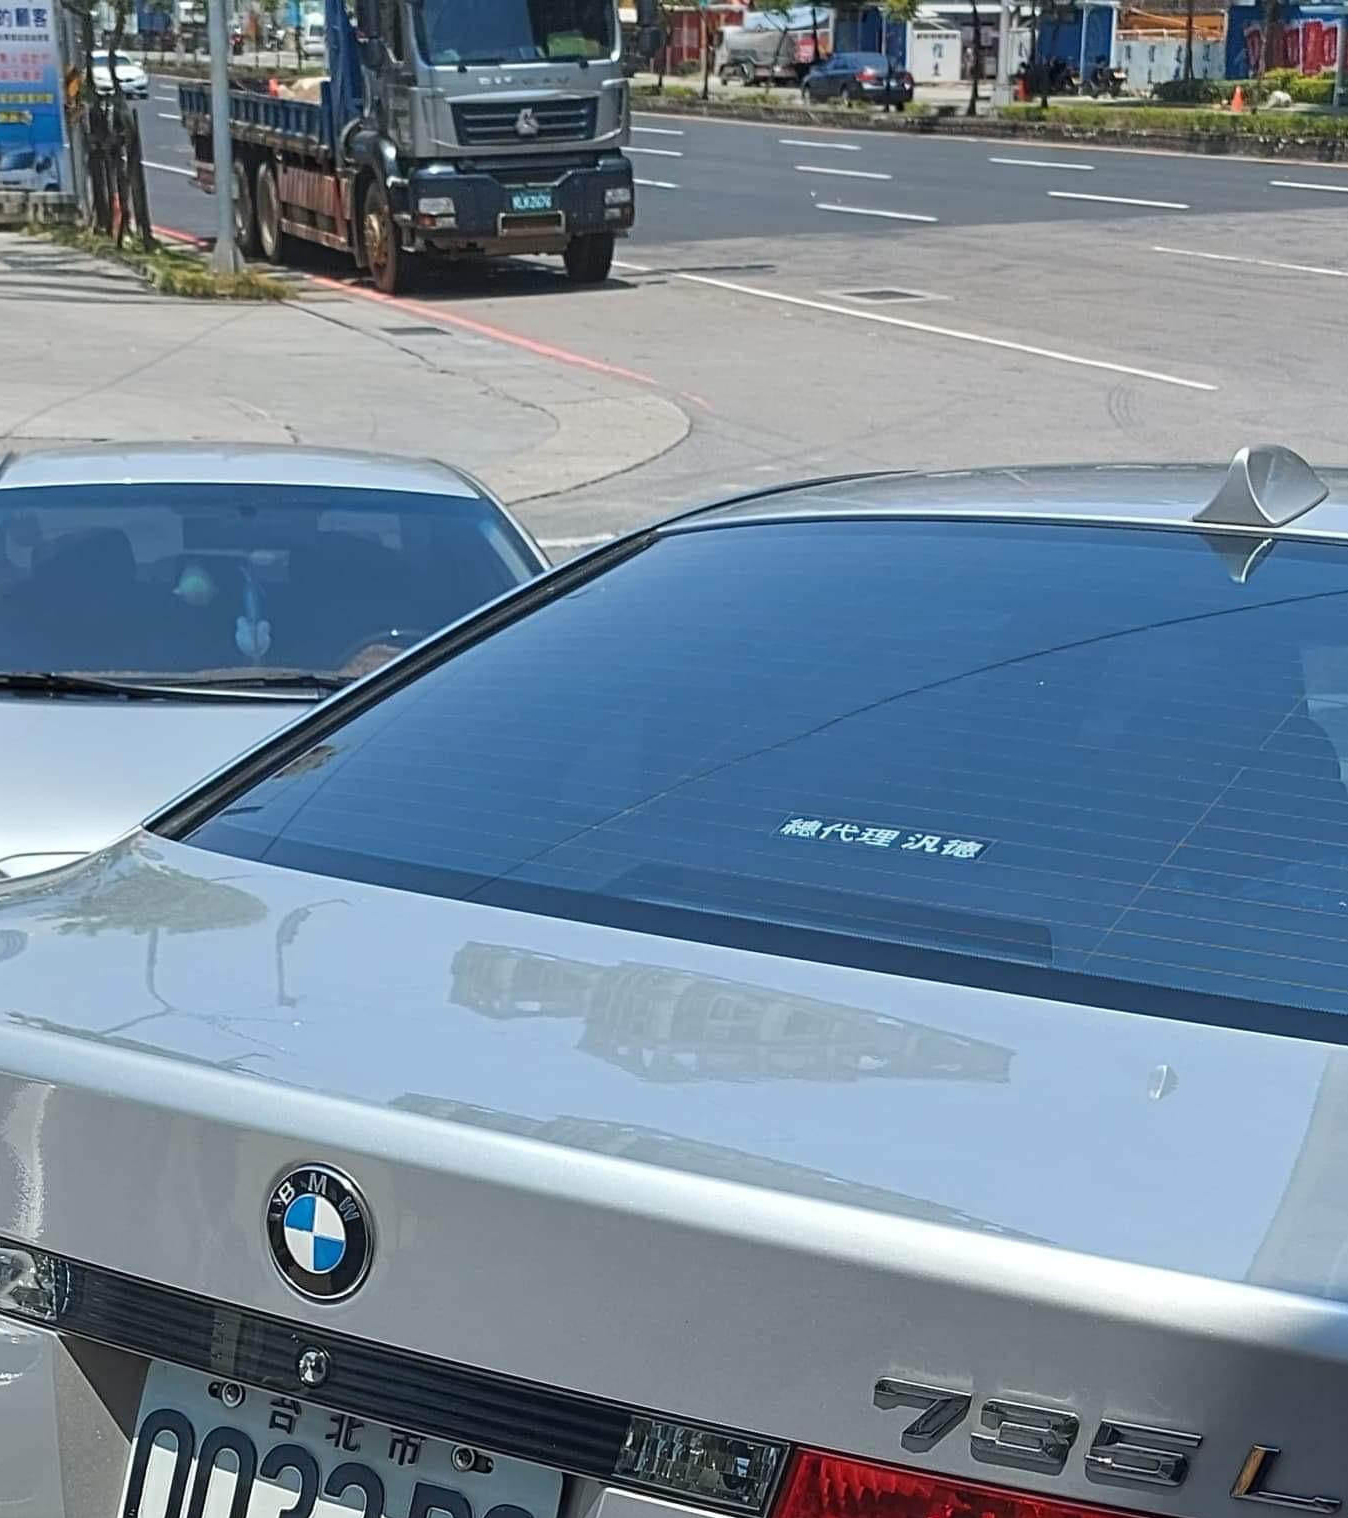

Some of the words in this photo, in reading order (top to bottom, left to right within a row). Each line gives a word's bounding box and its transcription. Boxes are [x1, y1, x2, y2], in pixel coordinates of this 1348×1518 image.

[779, 818, 901, 847] 總代理
[901, 833, 984, 859] 汎德
[277, 1172, 360, 1222] BMW
[268, 1397, 426, 1466] 台北市
